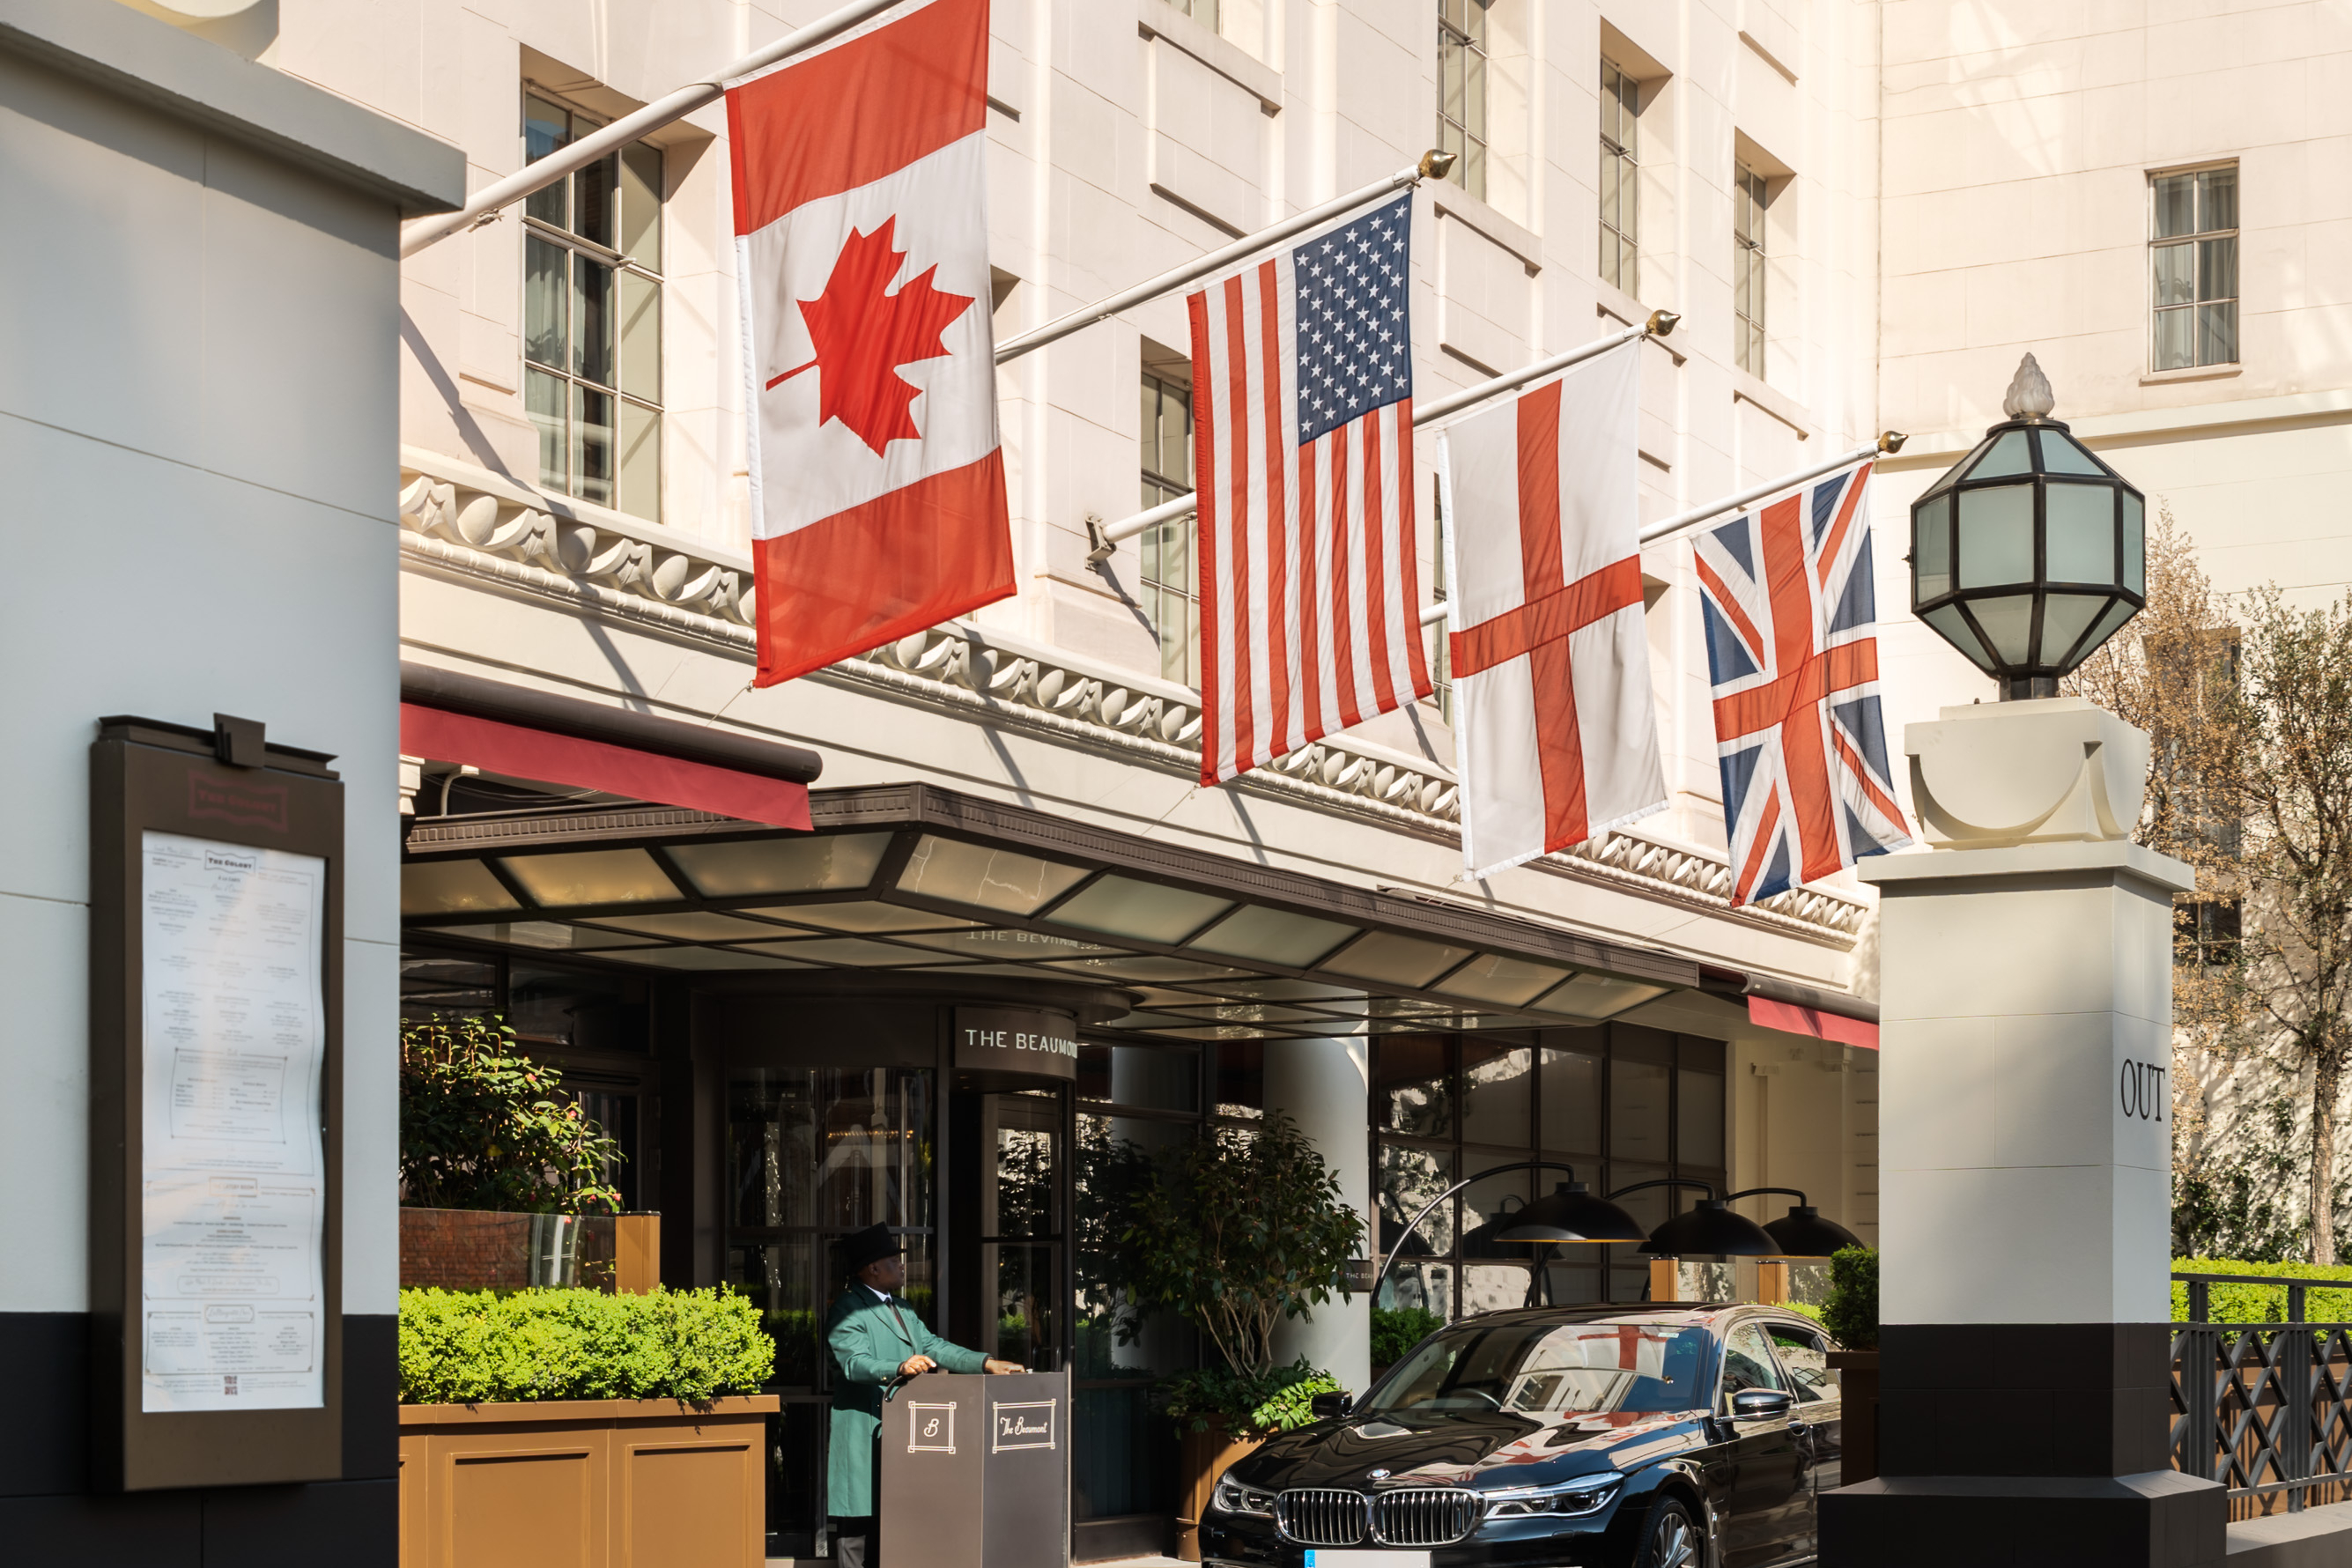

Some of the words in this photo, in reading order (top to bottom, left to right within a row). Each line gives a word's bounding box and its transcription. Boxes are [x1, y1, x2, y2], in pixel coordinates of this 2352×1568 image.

[965, 1029, 1008, 1048] THE
[2120, 1058, 2166, 1122] OUT
[923, 1417, 940, 1438] B
[999, 1416, 1014, 1436] The
[1014, 1416, 1048, 1436] Beaumont
